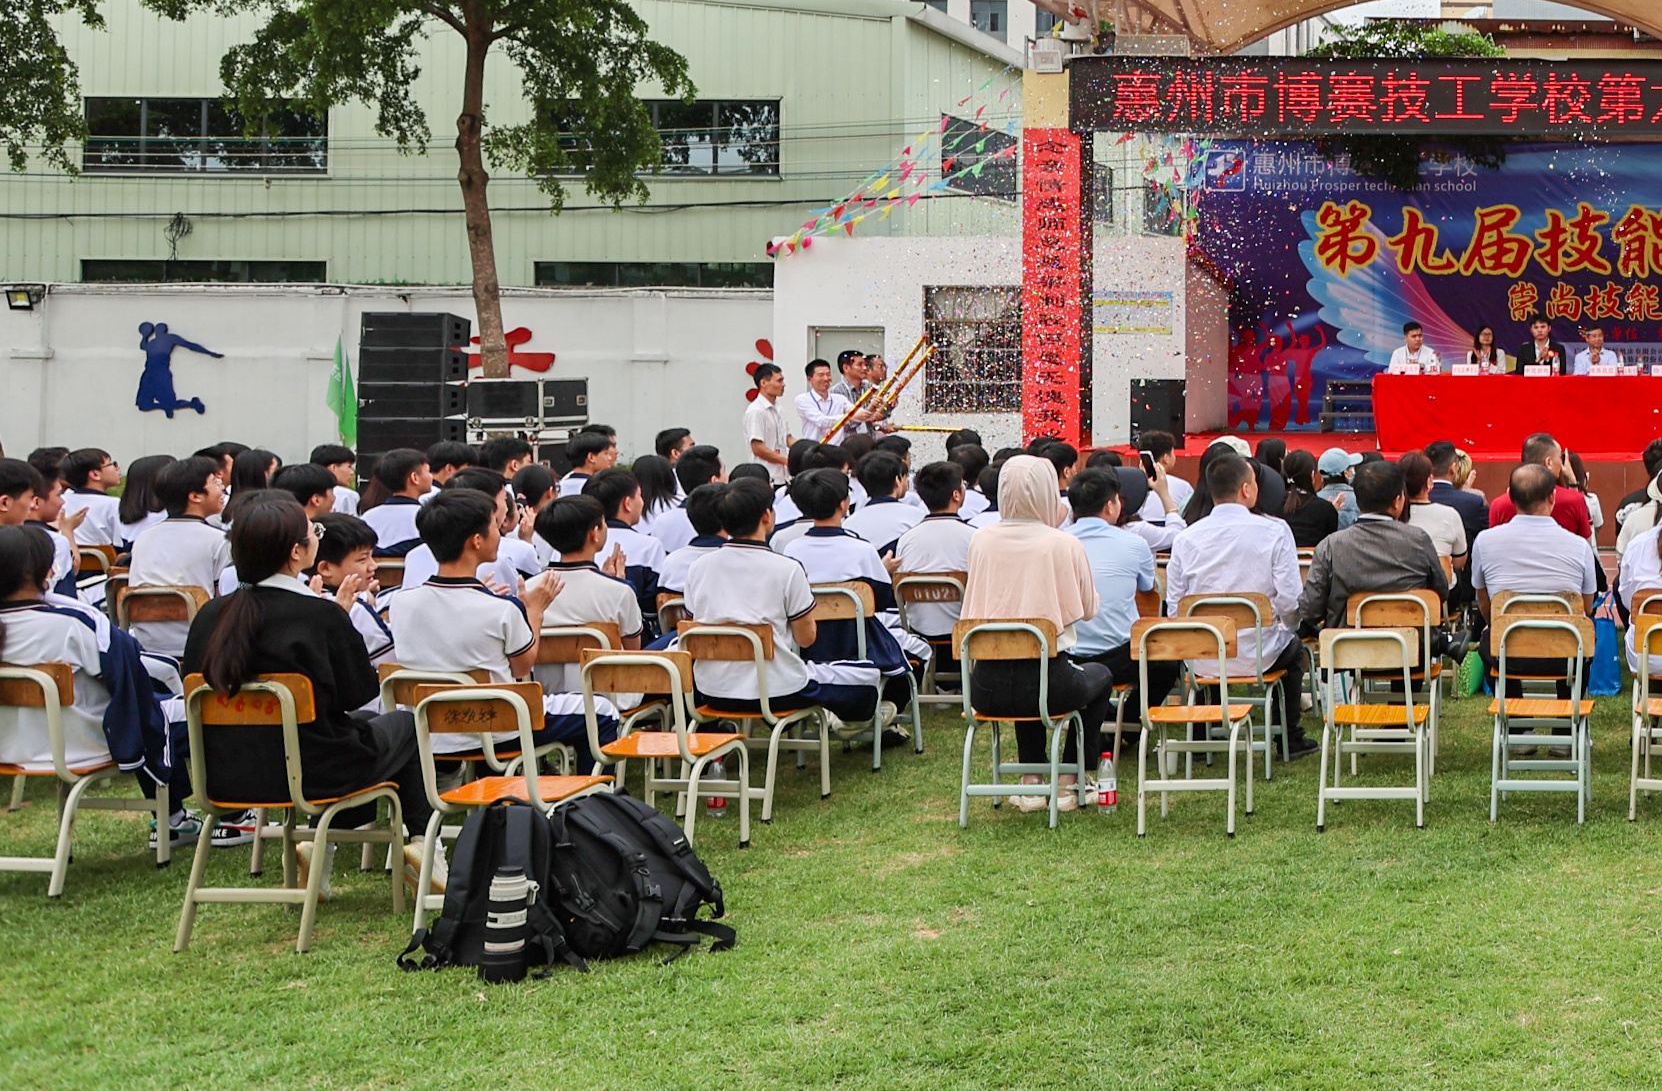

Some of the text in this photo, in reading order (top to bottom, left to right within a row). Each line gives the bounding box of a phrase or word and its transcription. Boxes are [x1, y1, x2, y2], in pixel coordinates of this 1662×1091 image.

[1253, 180, 1308, 191] Huizhou
[1311, 179, 1361, 194] Prosper
[1434, 180, 1477, 191] school
